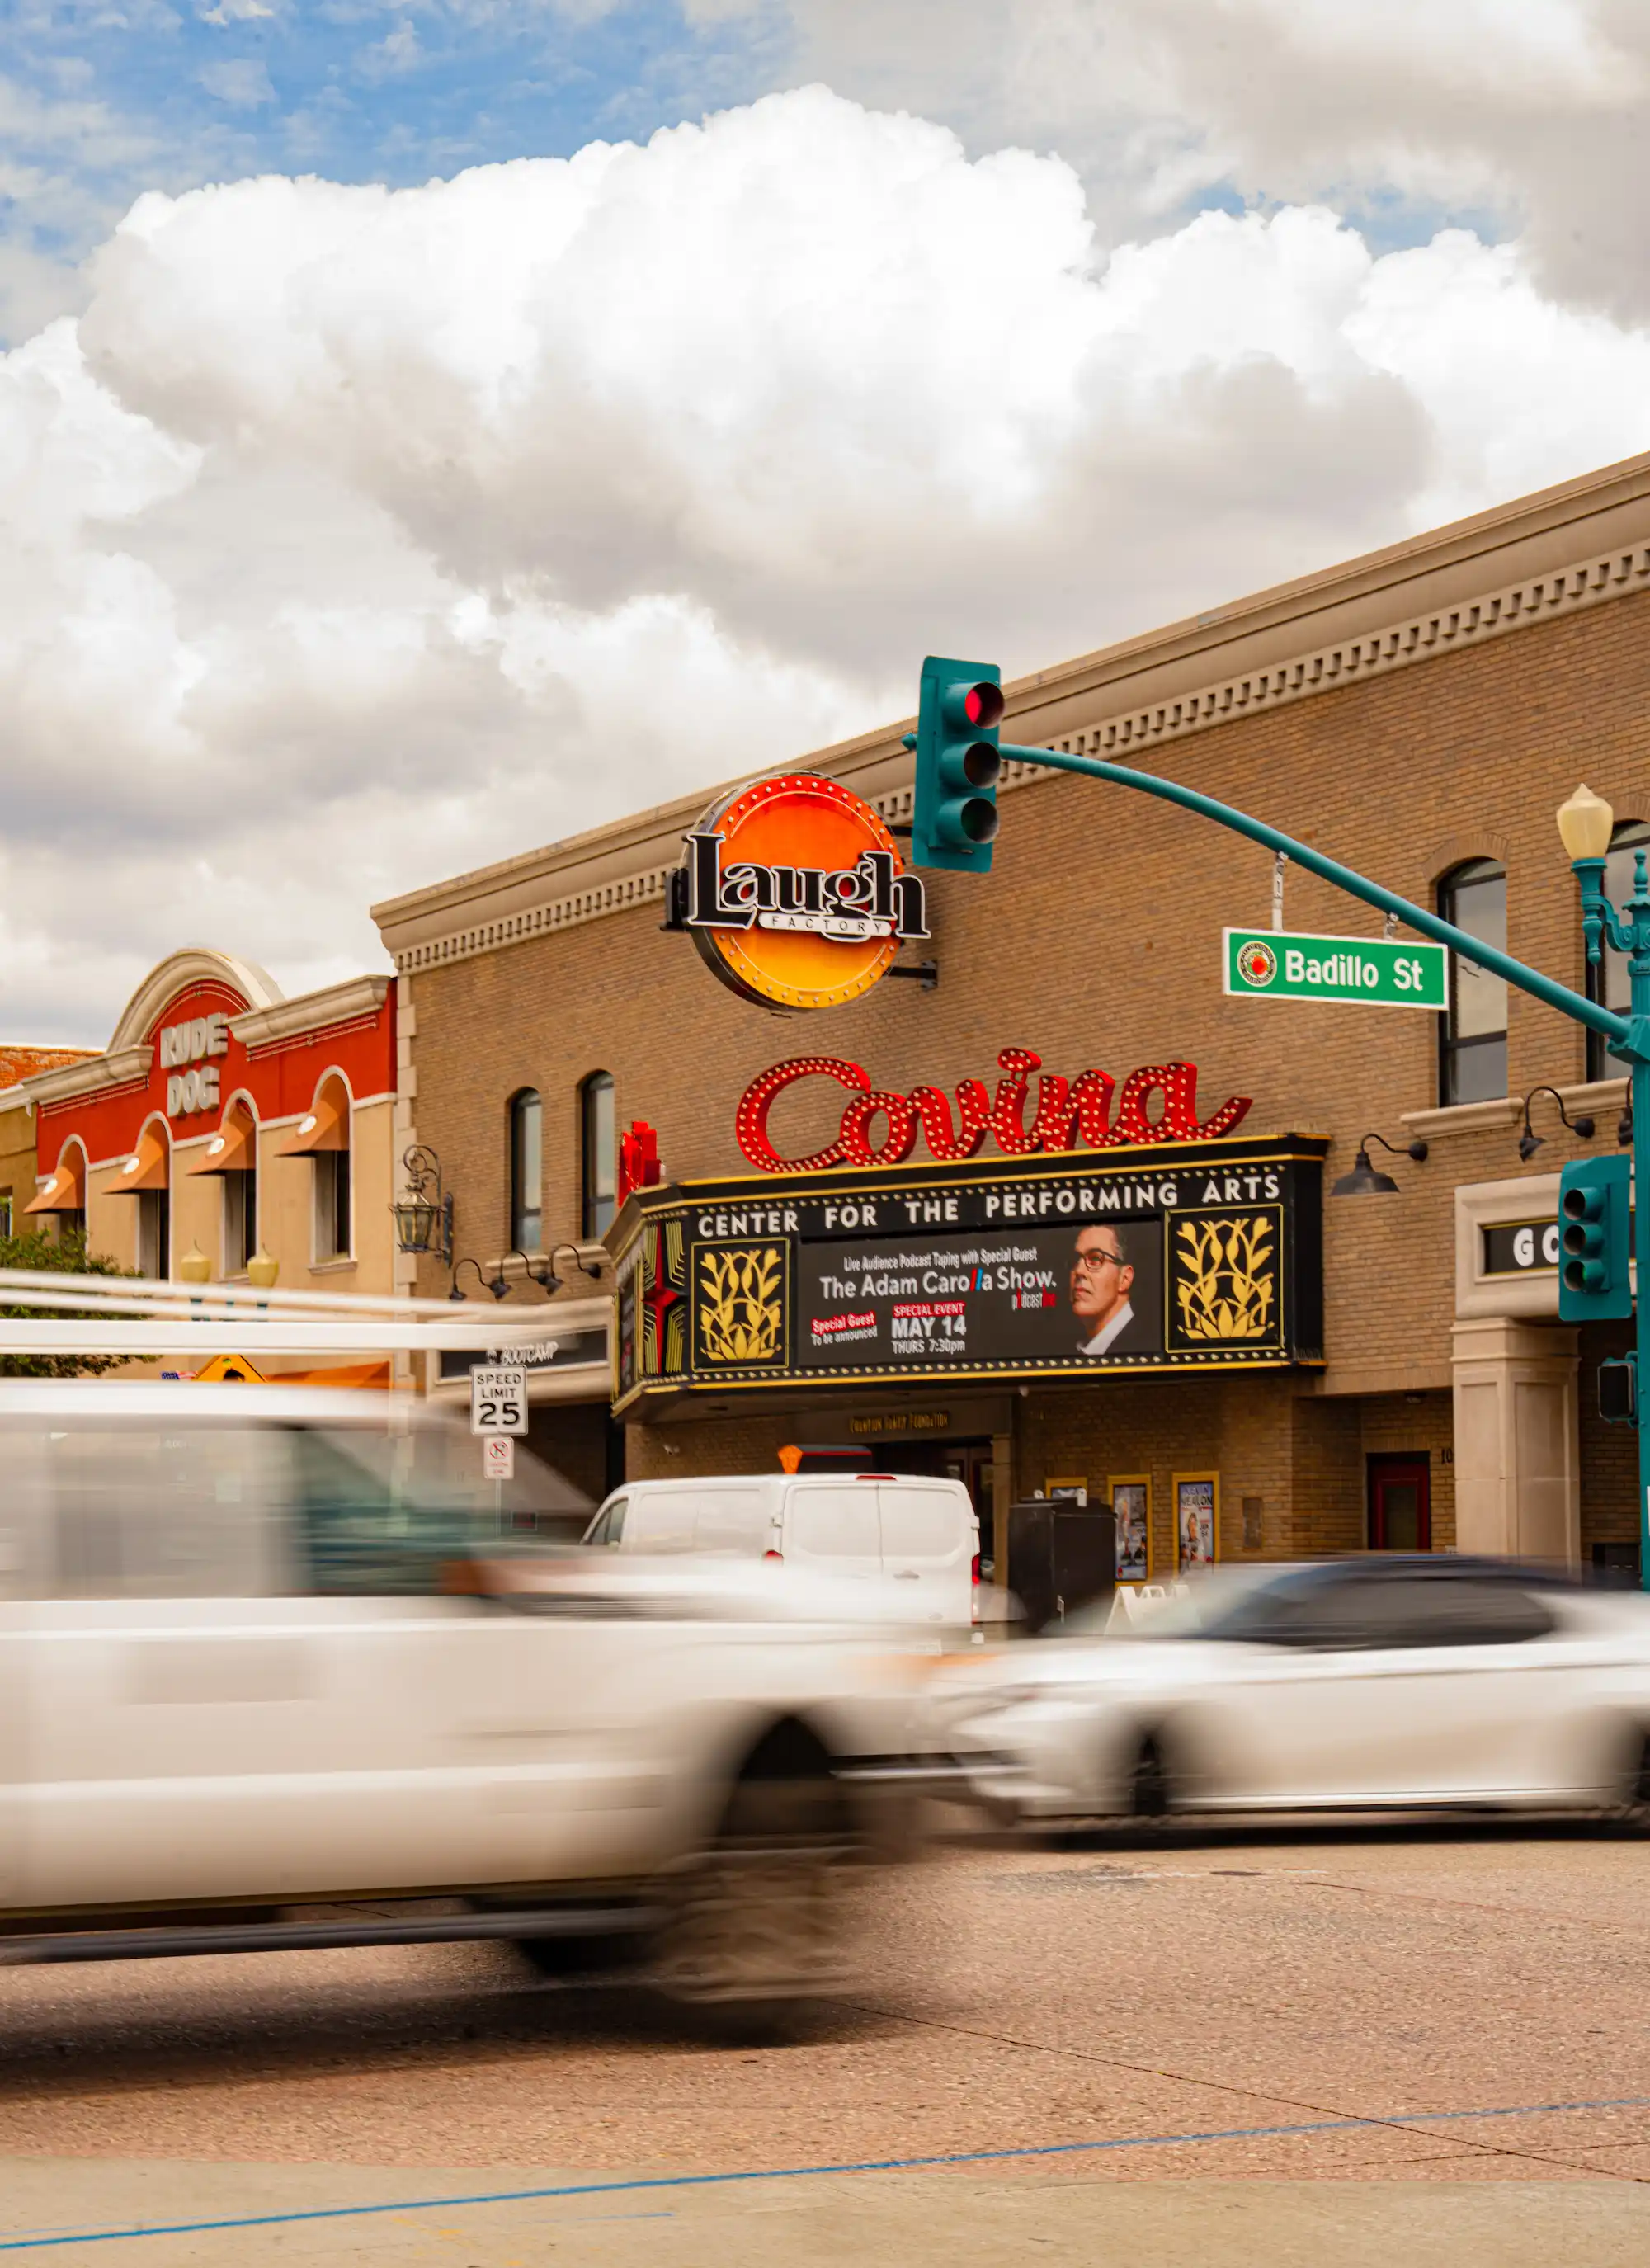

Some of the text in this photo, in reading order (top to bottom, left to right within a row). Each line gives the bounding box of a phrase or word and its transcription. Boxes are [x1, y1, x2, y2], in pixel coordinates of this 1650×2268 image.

[687, 832, 931, 941] Laugh
[771, 915, 883, 933] FACTORY
[1285, 950, 1379, 988] Badillo
[1393, 957, 1423, 991] St
[160, 1011, 228, 1069] RUDE
[167, 1065, 219, 1118] DOG
[736, 1047, 1252, 1174] Covina
[698, 1175, 1280, 1238] CENTER FOR THE PERFORMING ARTS
[843, 1247, 1037, 1272] Live Audience Podcast Taping with Special Guest
[819, 1276, 856, 1299] The
[860, 1273, 918, 1297] Adam
[997, 1266, 1057, 1290] Show.
[893, 1302, 964, 1317] SPECIAL EVENT
[812, 1312, 875, 1335] Special Guest
[891, 1315, 966, 1339] MAY 14
[810, 1326, 878, 1346] To be announced
[891, 1338, 966, 1355] THURS 7:30pm
[477, 1373, 521, 1384] SPEED
[482, 1388, 516, 1398] LIMIT
[478, 1402, 520, 1426] 25
